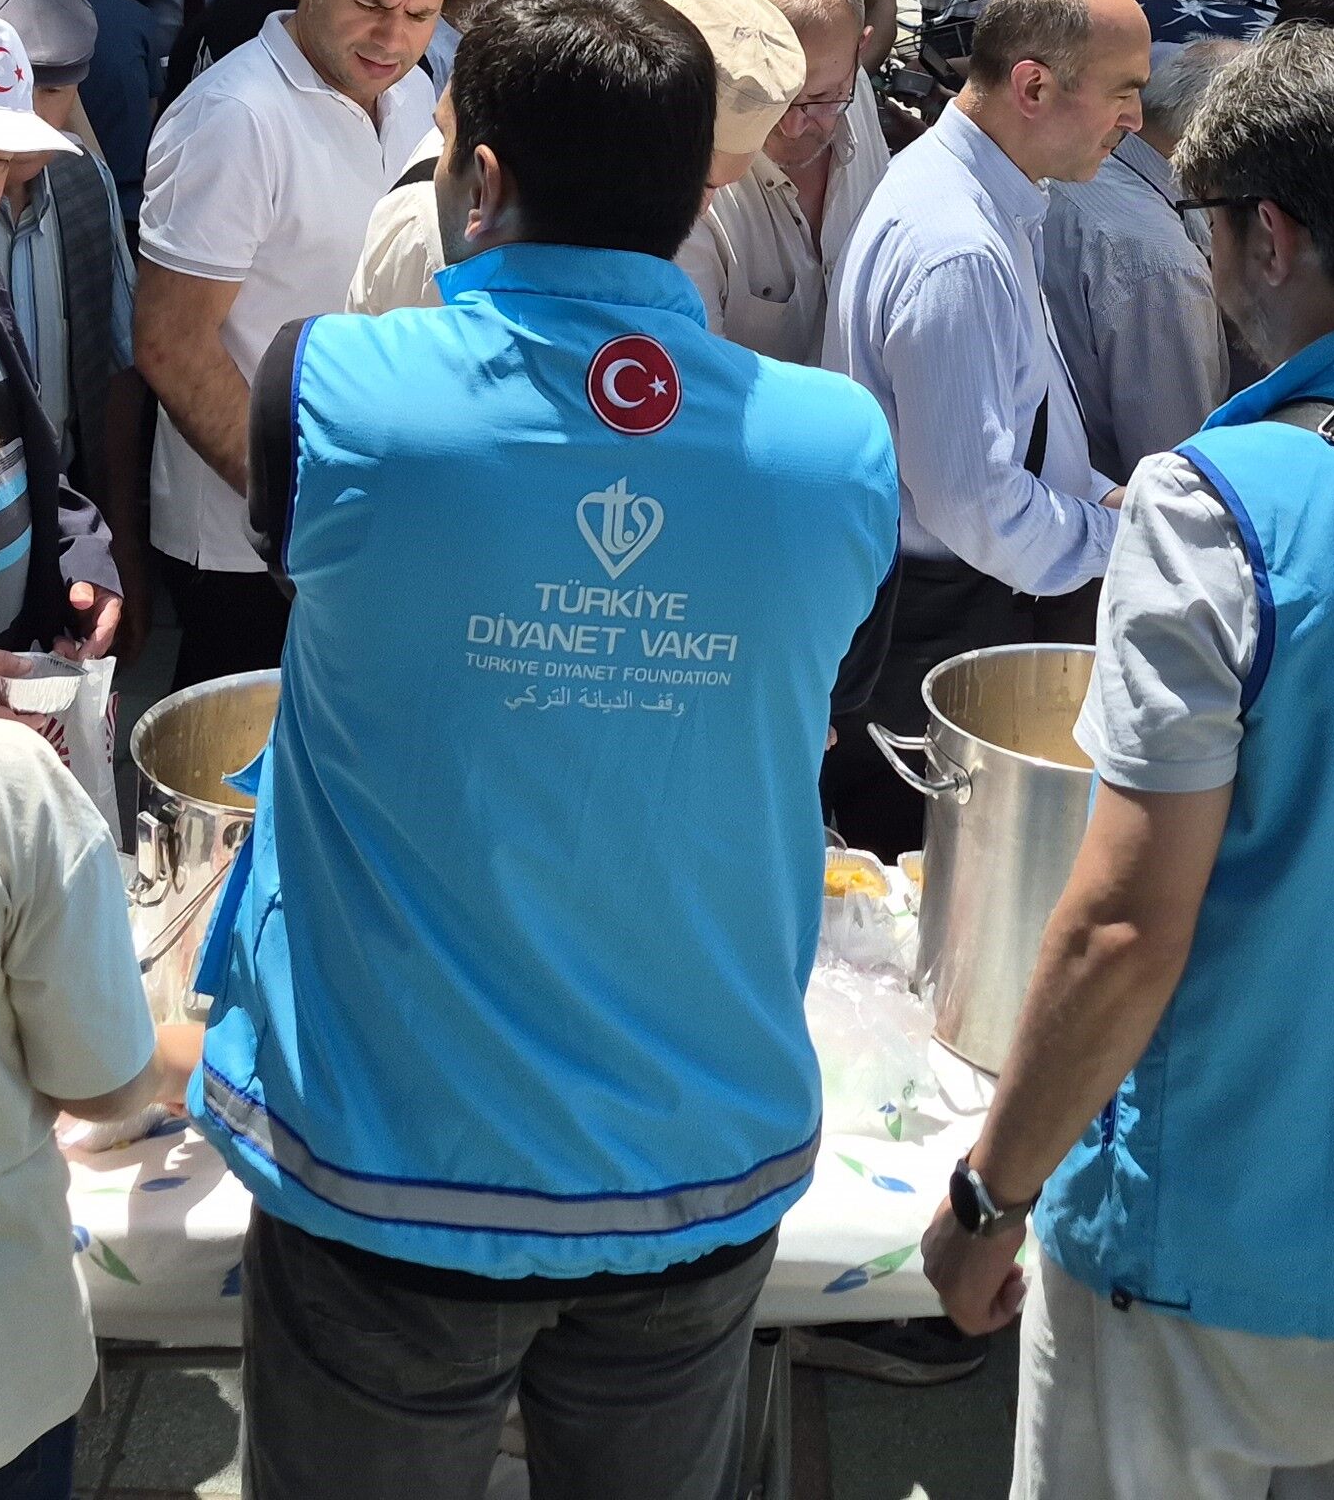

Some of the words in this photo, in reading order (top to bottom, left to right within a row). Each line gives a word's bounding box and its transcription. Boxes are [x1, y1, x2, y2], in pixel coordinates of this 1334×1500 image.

[534, 579, 689, 622] TÜRKİYE
[467, 612, 627, 655] DİYANET
[639, 627, 739, 662] VAKFI
[622, 667, 733, 687] FOUNDATION
[503, 684, 571, 712] التركي
[578, 688, 633, 715] الديانة
[639, 692, 685, 717] وقف
